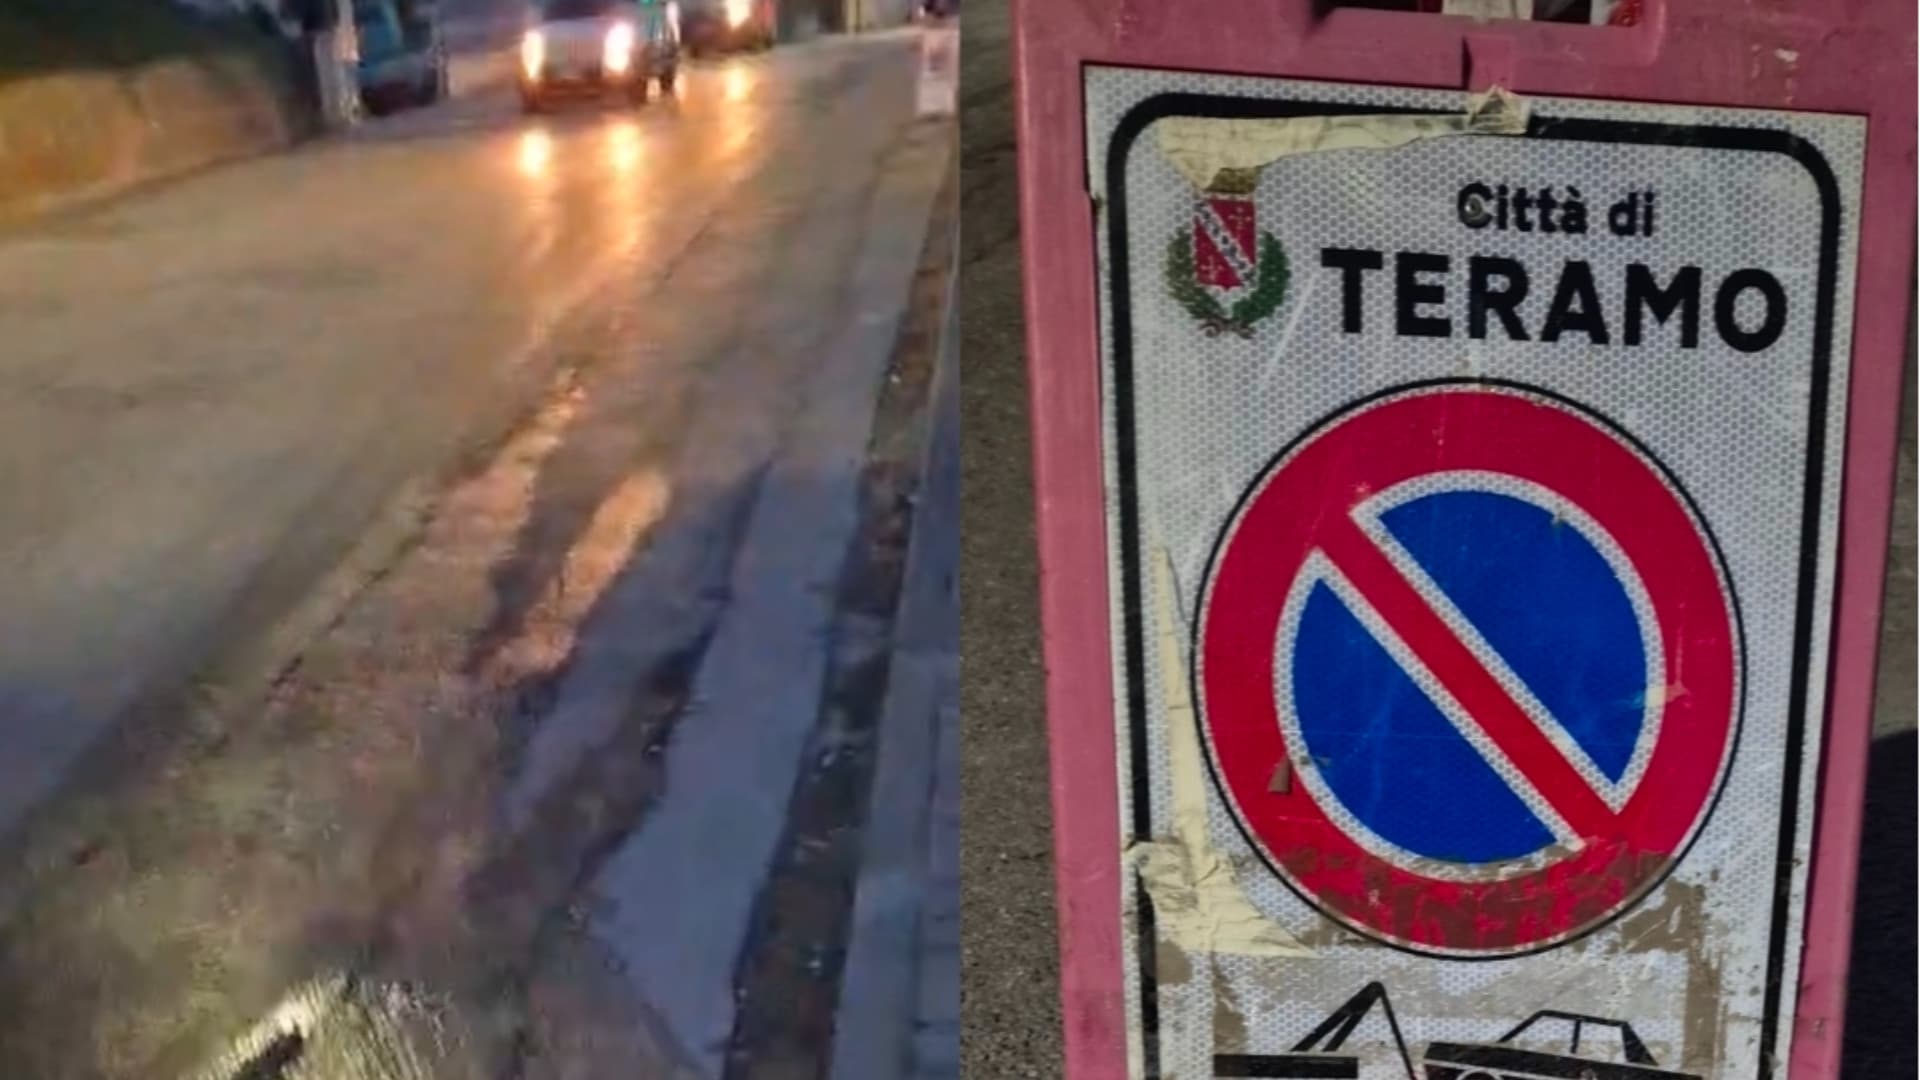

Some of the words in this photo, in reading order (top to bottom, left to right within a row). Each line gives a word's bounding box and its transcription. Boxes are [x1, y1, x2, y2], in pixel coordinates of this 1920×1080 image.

[1456, 182, 1587, 235] Città
[1608, 190, 1655, 237] di
[1320, 247, 1789, 353] TERAMO
